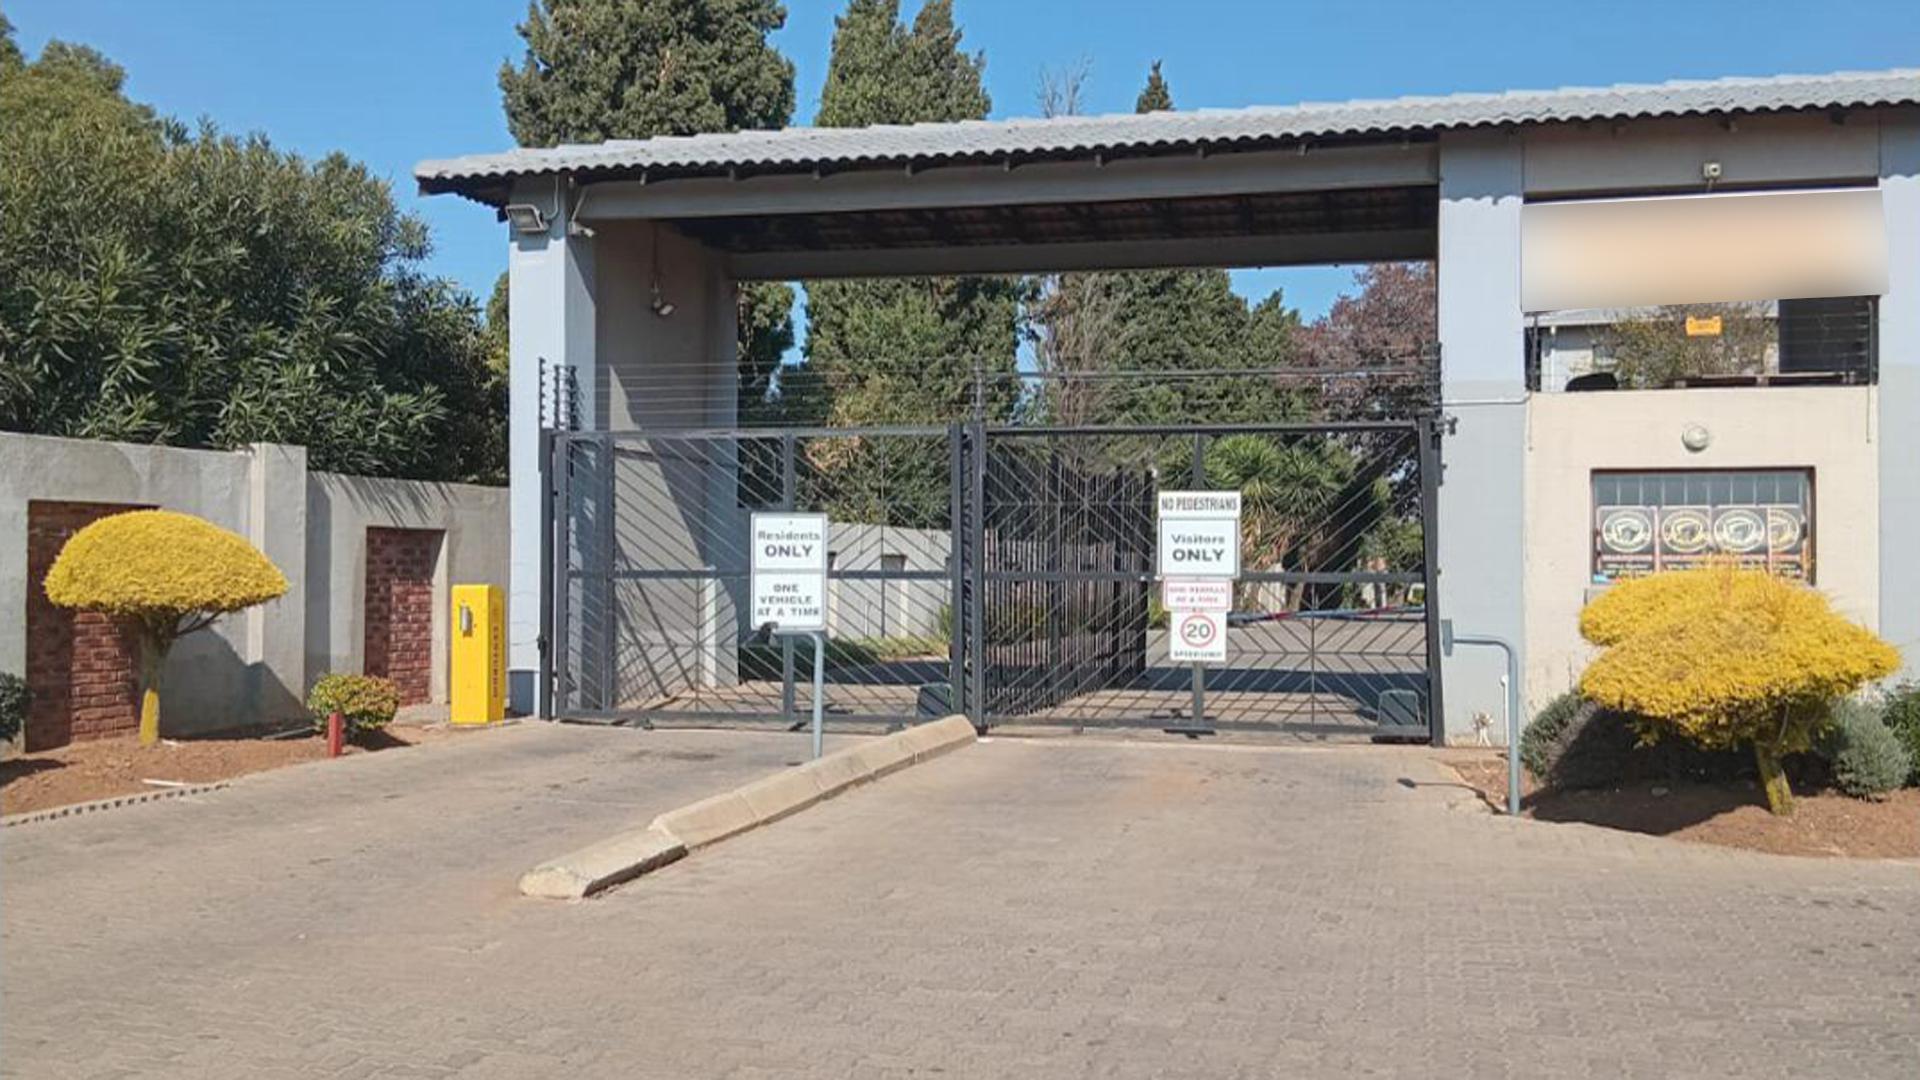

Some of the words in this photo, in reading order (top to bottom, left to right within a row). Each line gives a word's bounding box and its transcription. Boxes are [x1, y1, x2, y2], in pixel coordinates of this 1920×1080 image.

[1161, 497, 1174, 511] NO
[1176, 496, 1238, 511] PEDESTRIANS
[758, 530, 821, 541] Residents
[1171, 534, 1226, 544] Visitors
[765, 545, 813, 557] ONLY
[1172, 549, 1225, 561] ONLY
[773, 584, 799, 592] ONE
[759, 596, 813, 604] VEHICLE
[757, 608, 771, 616] AT
[777, 608, 785, 616] A
[1186, 624, 1211, 638] 20
